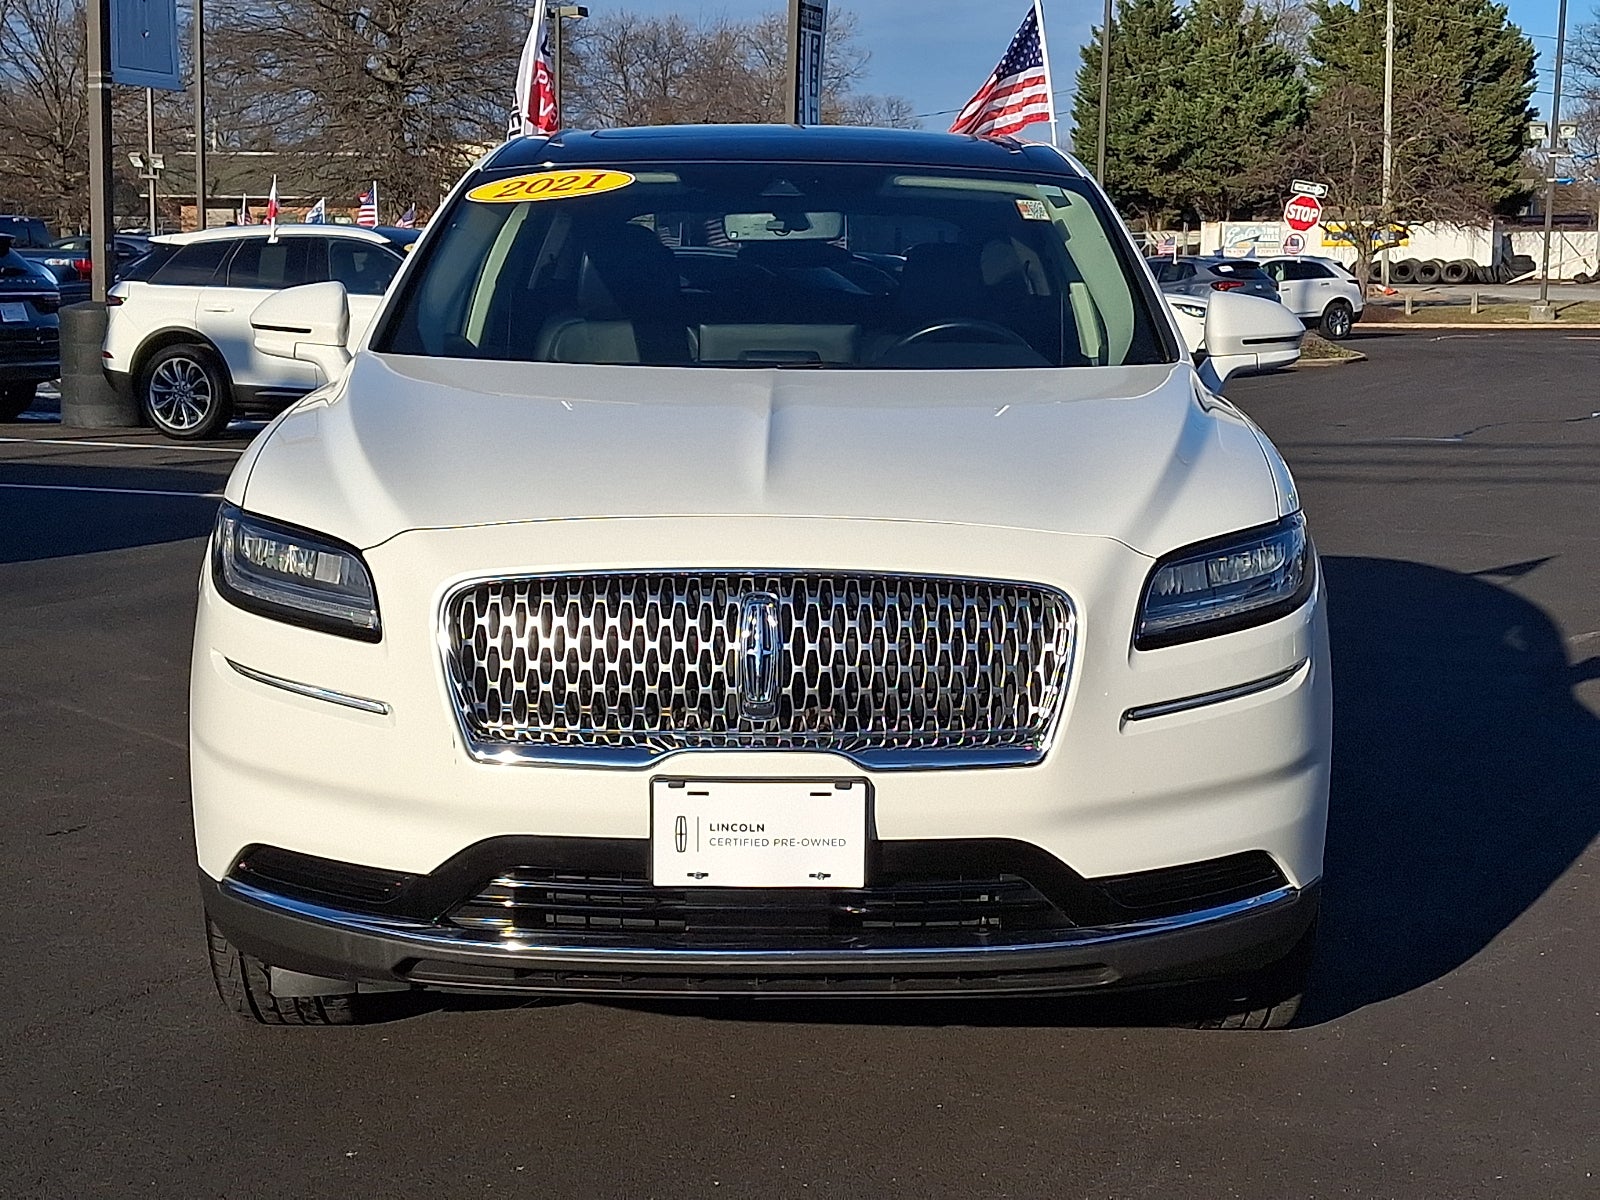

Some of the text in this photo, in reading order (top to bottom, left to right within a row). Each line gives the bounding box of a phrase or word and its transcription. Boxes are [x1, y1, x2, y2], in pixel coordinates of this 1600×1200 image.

[493, 173, 607, 198] 2021
[1286, 204, 1319, 223] STOP
[709, 823, 765, 832] LINCOLN
[709, 837, 847, 847] CERTIFIED PRE-OWNED
